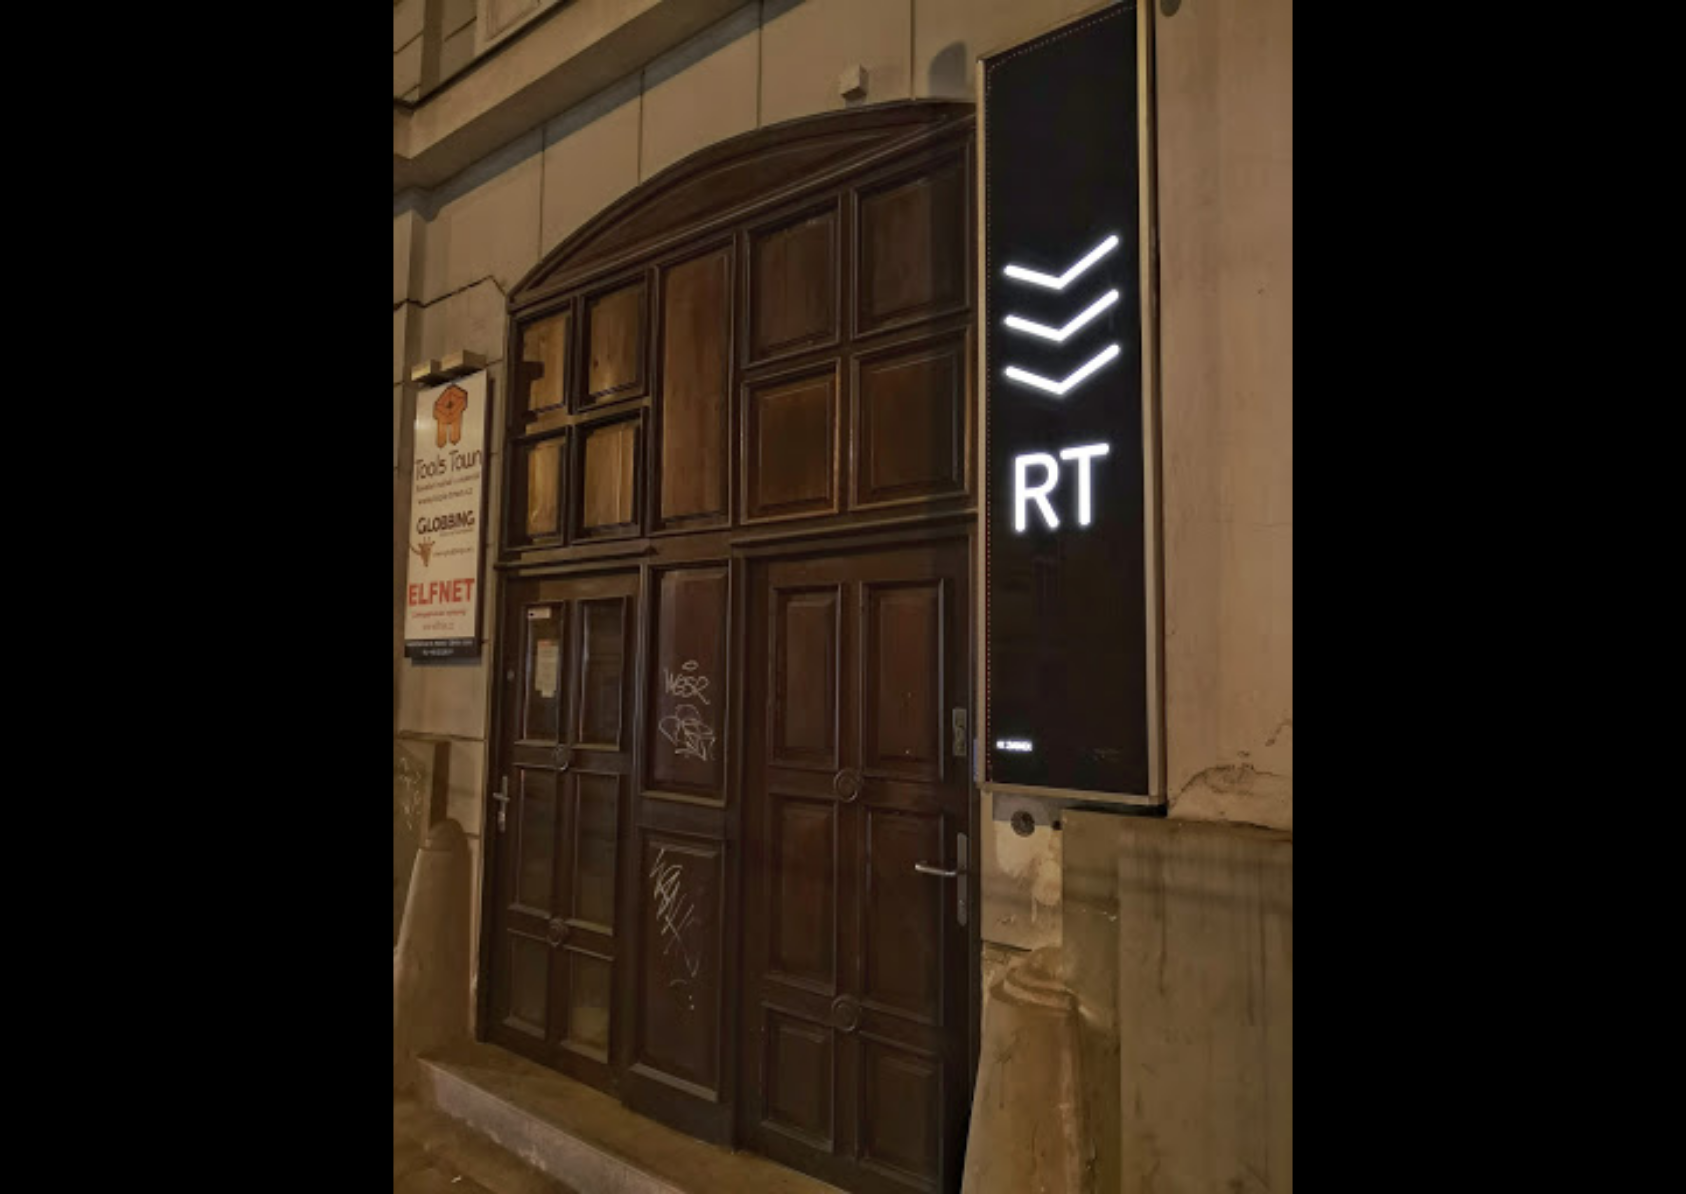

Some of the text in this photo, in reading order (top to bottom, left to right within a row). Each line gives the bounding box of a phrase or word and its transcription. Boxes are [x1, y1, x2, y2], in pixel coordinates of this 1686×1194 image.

[449, 449, 482, 472] Town
[1014, 442, 1110, 533] RT
[416, 510, 475, 535] GLOBBING
[408, 577, 476, 607] ELFNET
